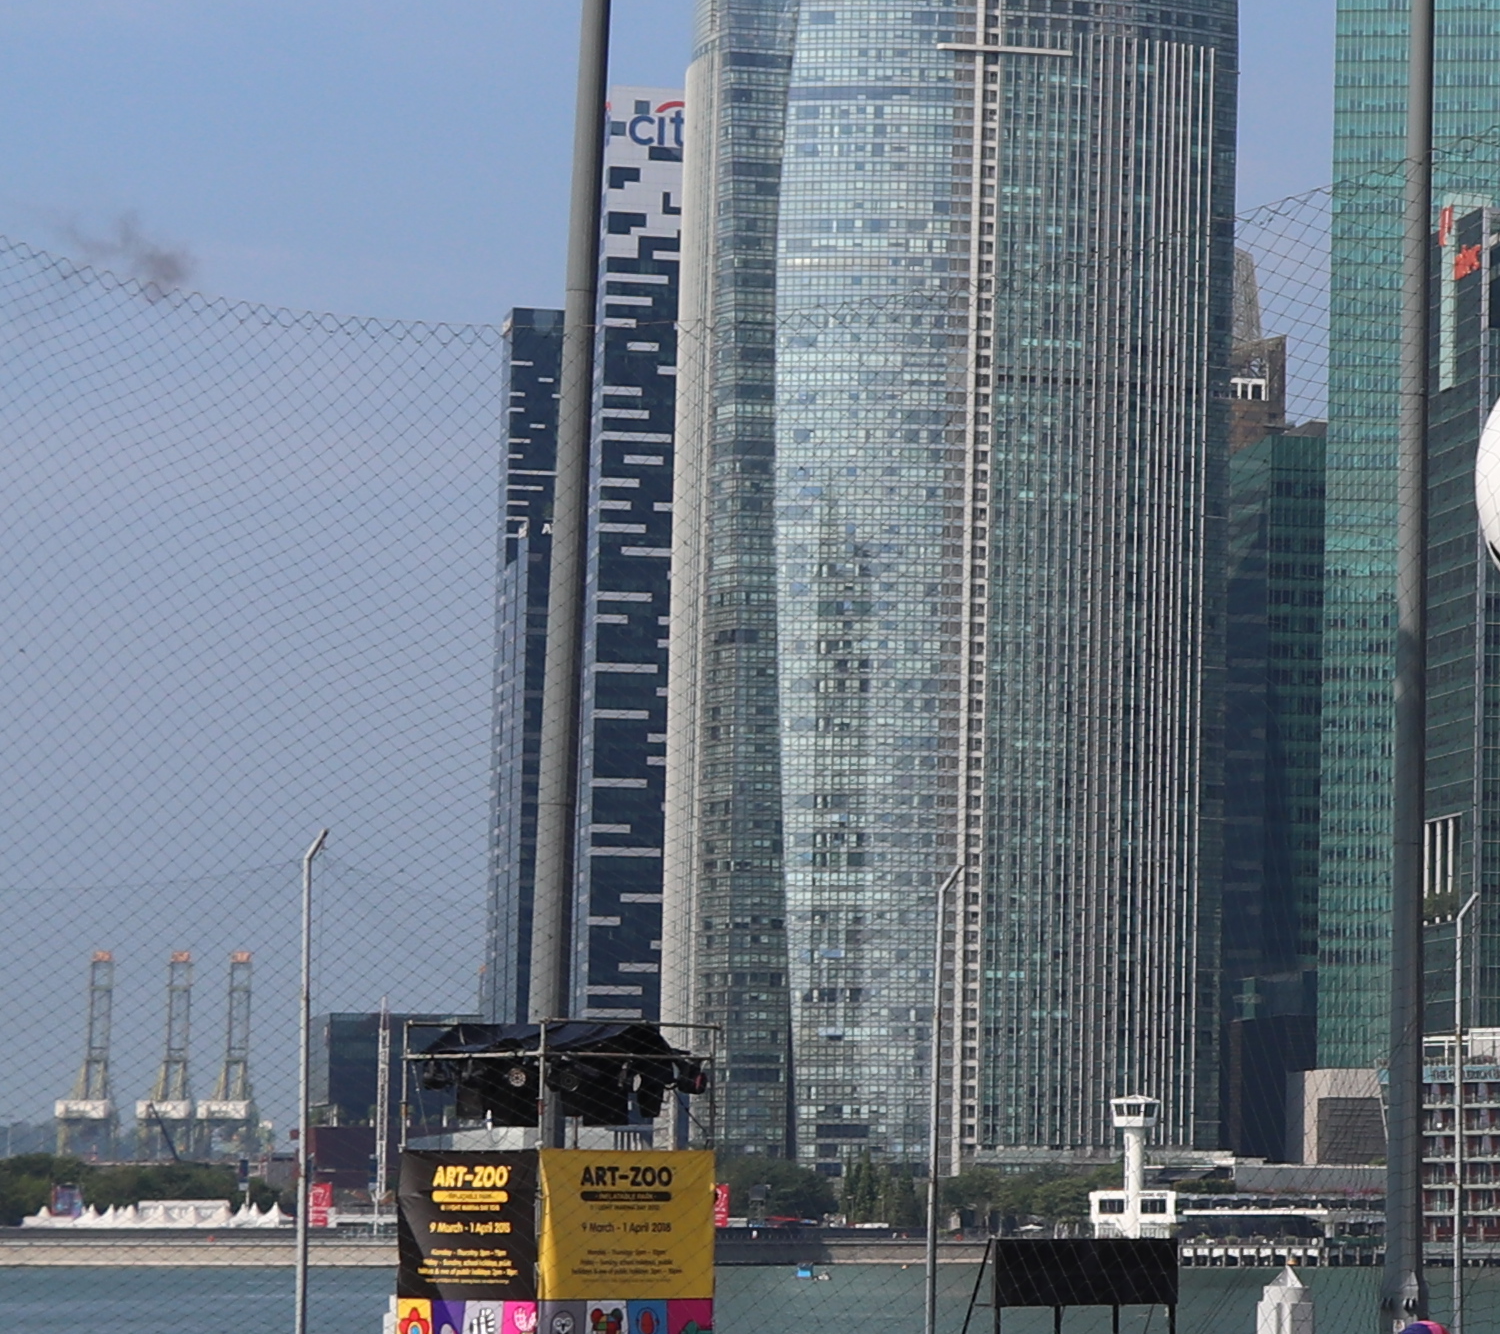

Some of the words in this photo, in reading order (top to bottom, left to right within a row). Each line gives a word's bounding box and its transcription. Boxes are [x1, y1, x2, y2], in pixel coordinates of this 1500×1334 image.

[629, 109, 685, 148] cit
[432, 1165, 509, 1188] ART-ZOO
[580, 1165, 673, 1187] ART-ZOO
